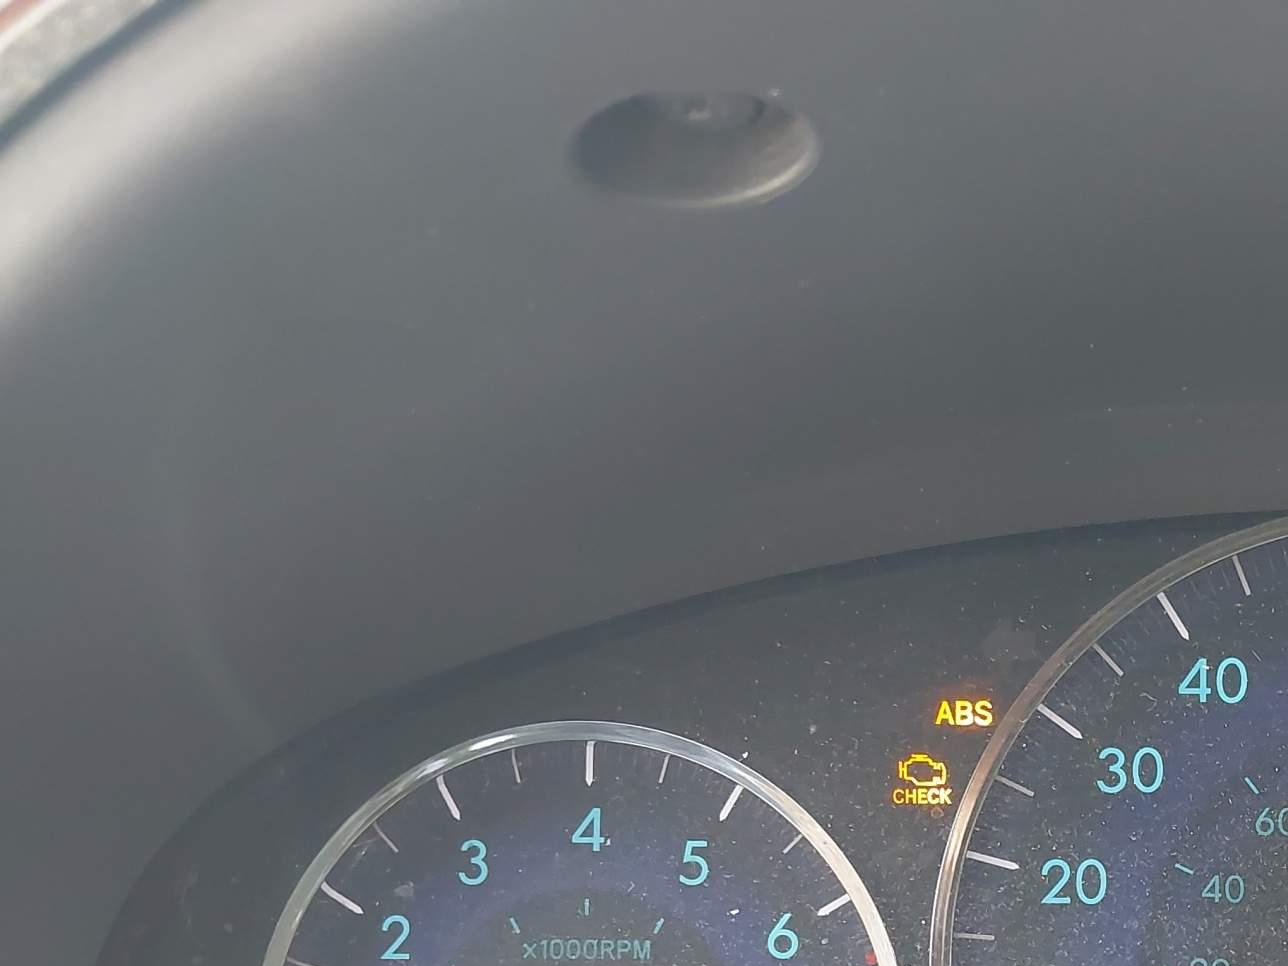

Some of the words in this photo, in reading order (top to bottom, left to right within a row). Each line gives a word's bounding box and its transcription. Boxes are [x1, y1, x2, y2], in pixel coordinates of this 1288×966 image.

[1178, 656, 1248, 705] 40
[935, 700, 993, 727] ABS
[1097, 746, 1164, 795] 30
[892, 787, 952, 806] CHECK
[571, 807, 607, 851] 4
[458, 839, 488, 886] 3
[679, 840, 709, 886] 5
[1040, 858, 1108, 905] 20
[1202, 873, 1245, 904] 40
[380, 915, 410, 960] 2
[523, 939, 651, 960] x1000RPM
[767, 913, 799, 960] 6
